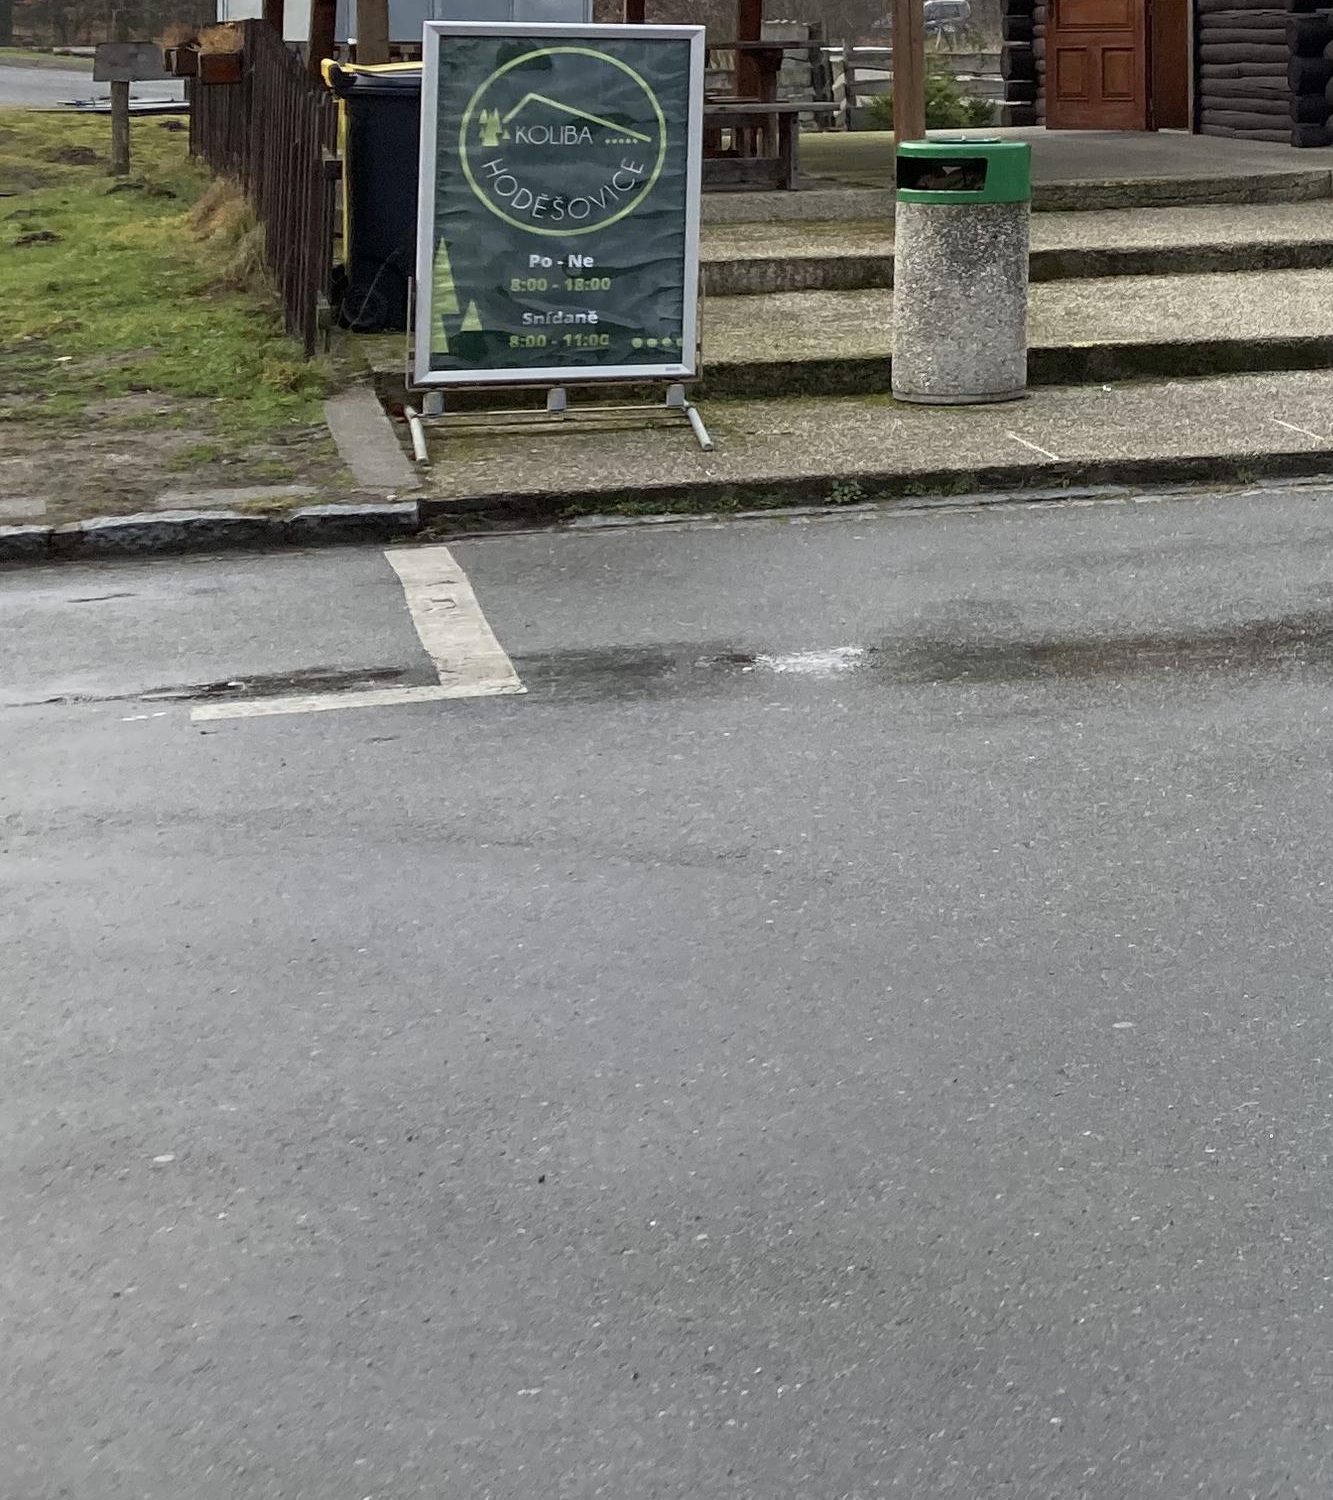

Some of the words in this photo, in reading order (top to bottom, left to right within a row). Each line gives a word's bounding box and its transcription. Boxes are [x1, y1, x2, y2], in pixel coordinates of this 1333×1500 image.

[515, 125, 594, 145] KOLIBA
[481, 157, 644, 221] HODĚŠOVICE
[529, 254, 552, 268] Po
[568, 254, 594, 268] Ne
[510, 278, 548, 292] 8:00
[565, 277, 611, 292] 18:00
[522, 310, 599, 325] Snídaně
[509, 334, 546, 348] 8:00
[563, 333, 609, 347] 11:00
